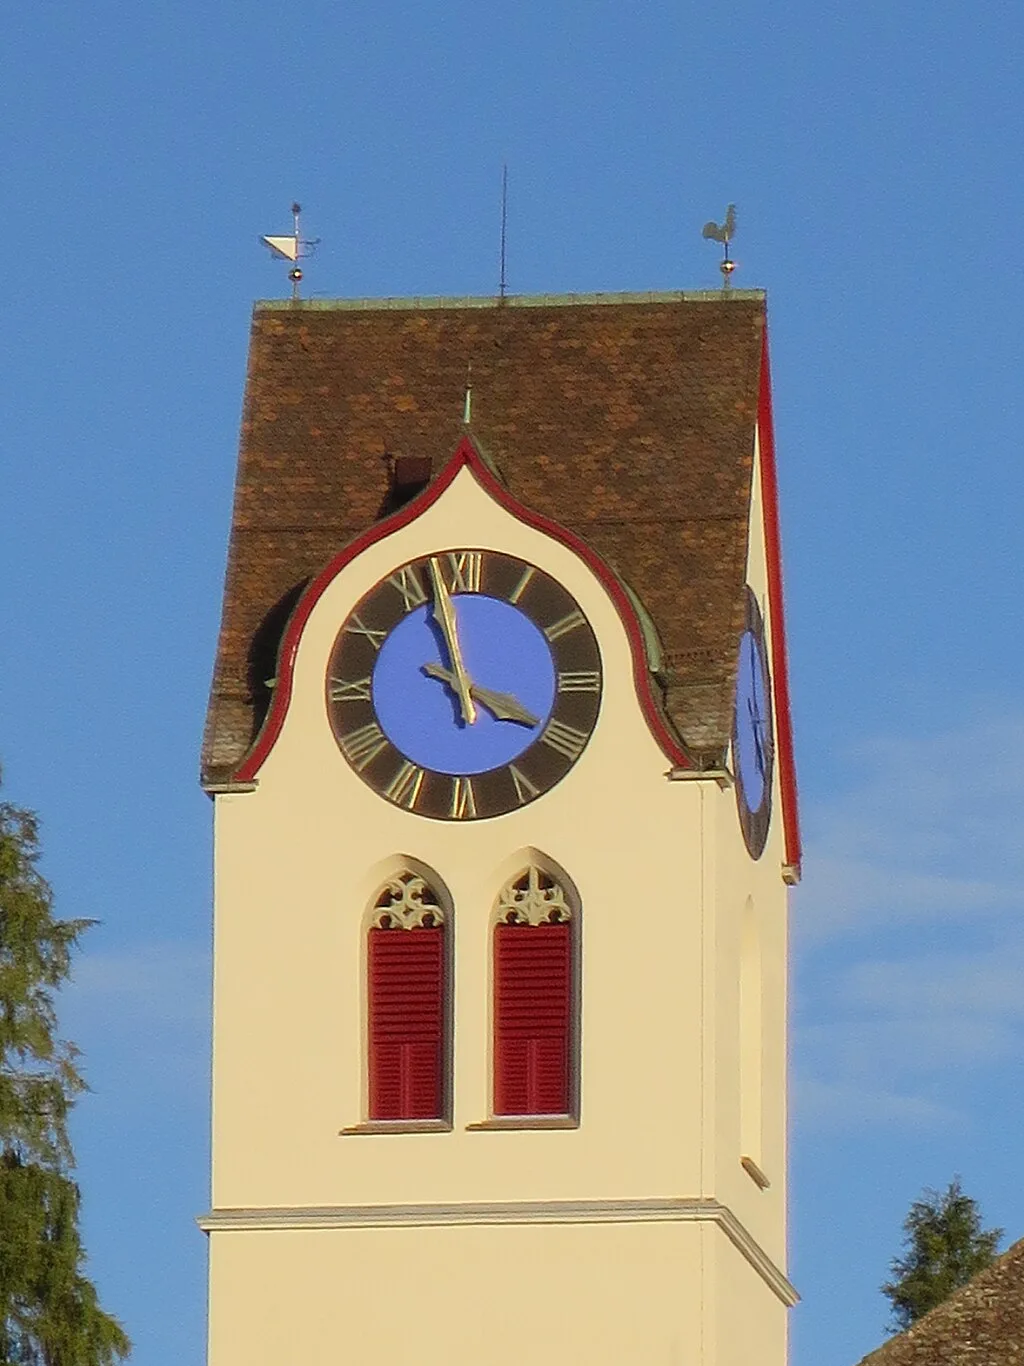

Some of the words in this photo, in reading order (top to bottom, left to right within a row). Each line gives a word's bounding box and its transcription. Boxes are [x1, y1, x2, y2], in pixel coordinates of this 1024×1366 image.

[388, 564, 428, 612] XI
[447, 552, 481, 594] XII
[509, 564, 535, 604] I
[344, 613, 388, 650] X
[543, 610, 586, 642] II
[330, 676, 371, 701] IX
[558, 671, 600, 692] III
[340, 721, 390, 772] VIII
[542, 718, 589, 761] IIII
[384, 759, 424, 809] VII
[448, 777, 477, 819] VI
[508, 763, 540, 804] V
